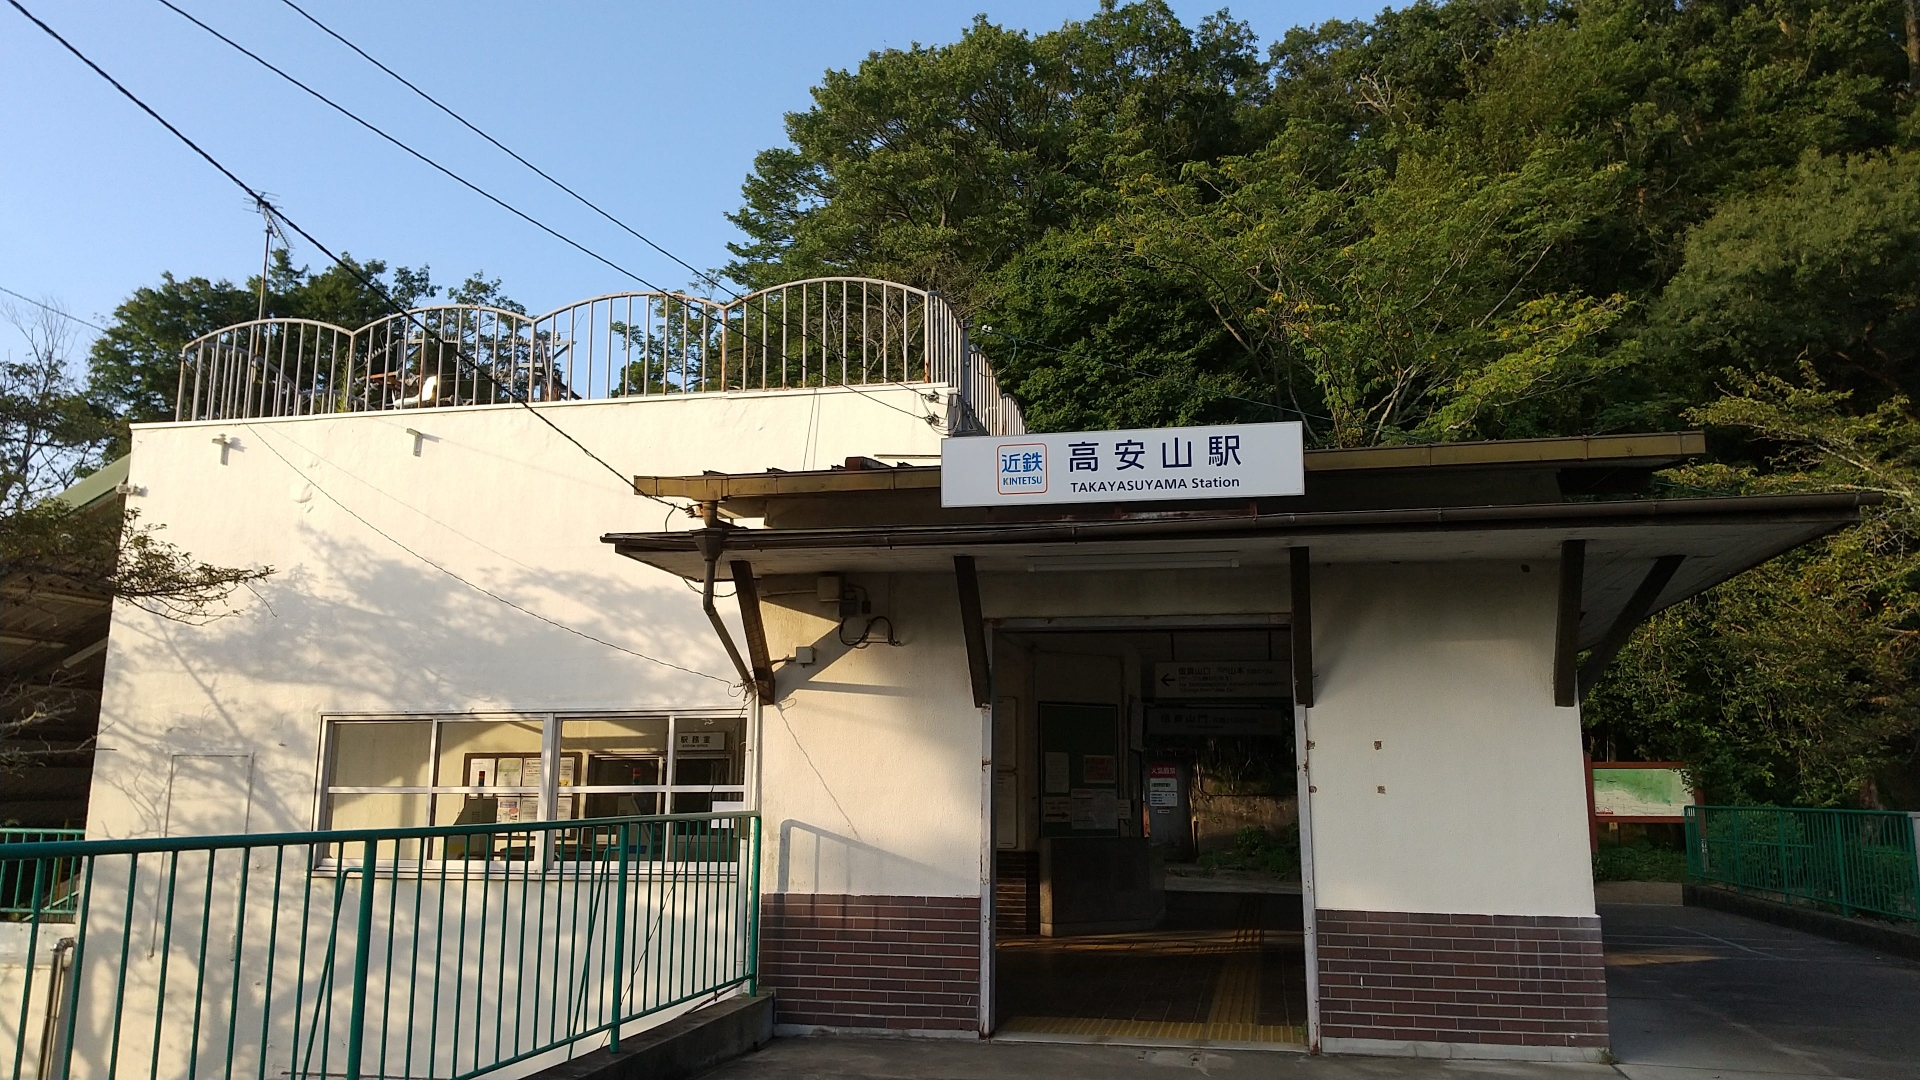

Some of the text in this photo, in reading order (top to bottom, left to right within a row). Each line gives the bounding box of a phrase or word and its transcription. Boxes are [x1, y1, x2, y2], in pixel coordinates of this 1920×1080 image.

[1068, 435, 1241, 473] 高安山駅
[1002, 451, 1043, 473] 近鉄
[1003, 476, 1042, 485] KINTETSU
[1071, 477, 1240, 492] TAKAYASUYAMA Station
[681, 735, 711, 744] 駅務室
